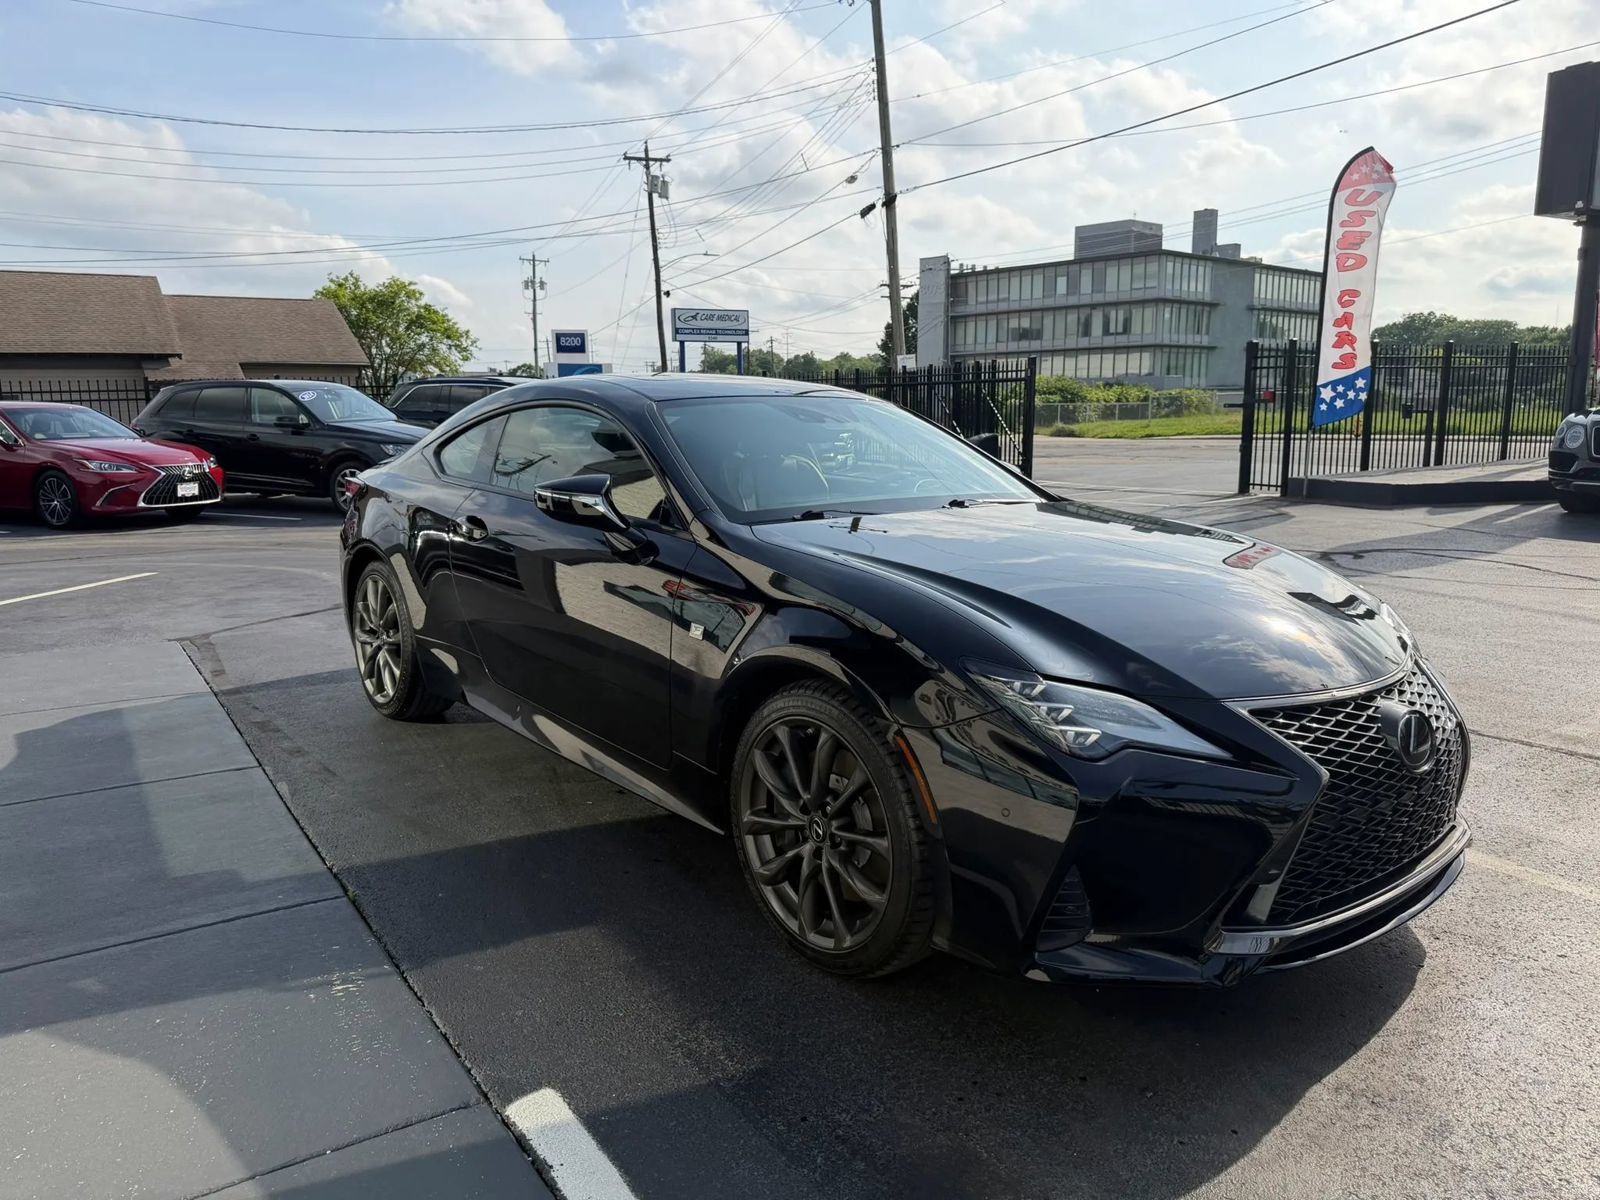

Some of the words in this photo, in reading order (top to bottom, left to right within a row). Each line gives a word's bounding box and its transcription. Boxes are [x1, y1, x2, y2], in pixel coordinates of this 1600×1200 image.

[1336, 188, 1384, 272] USED
[700, 313, 715, 321] CARE
[716, 314, 740, 322] MEDICAL
[1331, 288, 1361, 370] CARS
[560, 336, 581, 346] 8200
